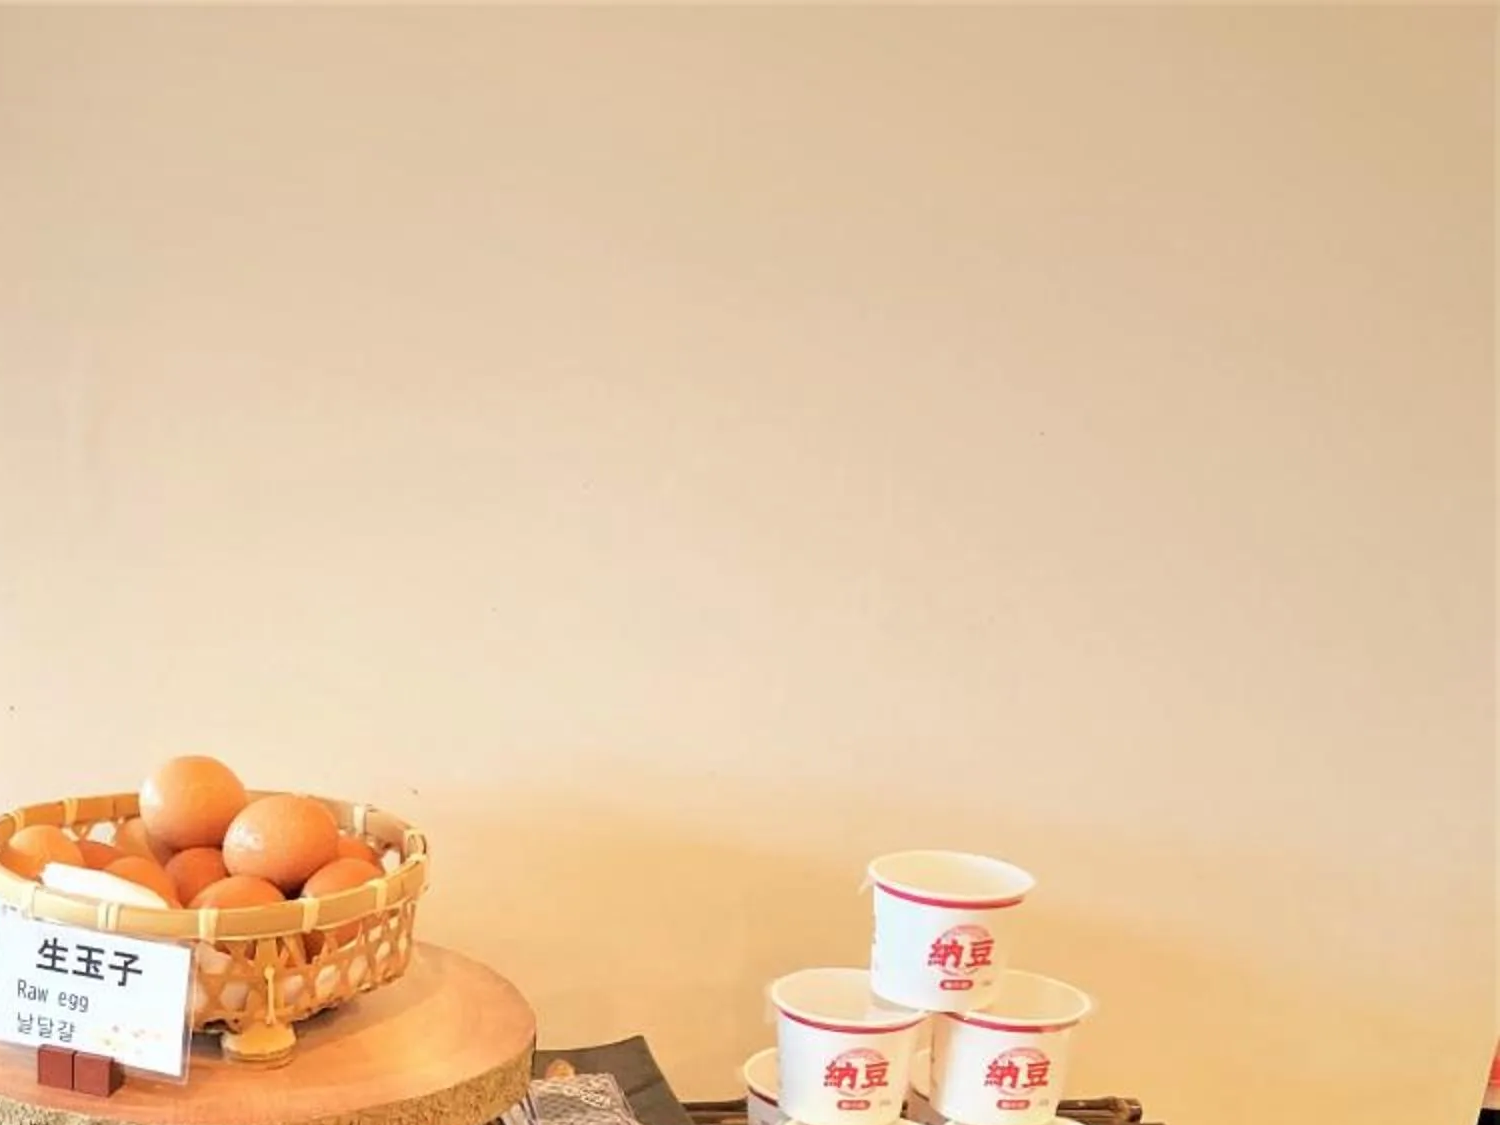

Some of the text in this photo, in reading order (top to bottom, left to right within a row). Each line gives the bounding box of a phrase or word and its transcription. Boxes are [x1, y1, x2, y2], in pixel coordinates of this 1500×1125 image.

[36, 937, 143, 986] 生玉子
[927, 937, 995, 968] 納豆
[18, 979, 89, 1013] Raw egg
[17, 1011, 76, 1042] 날달걀
[823, 1060, 890, 1089] 納豆
[984, 1058, 1051, 1089] 納豆
